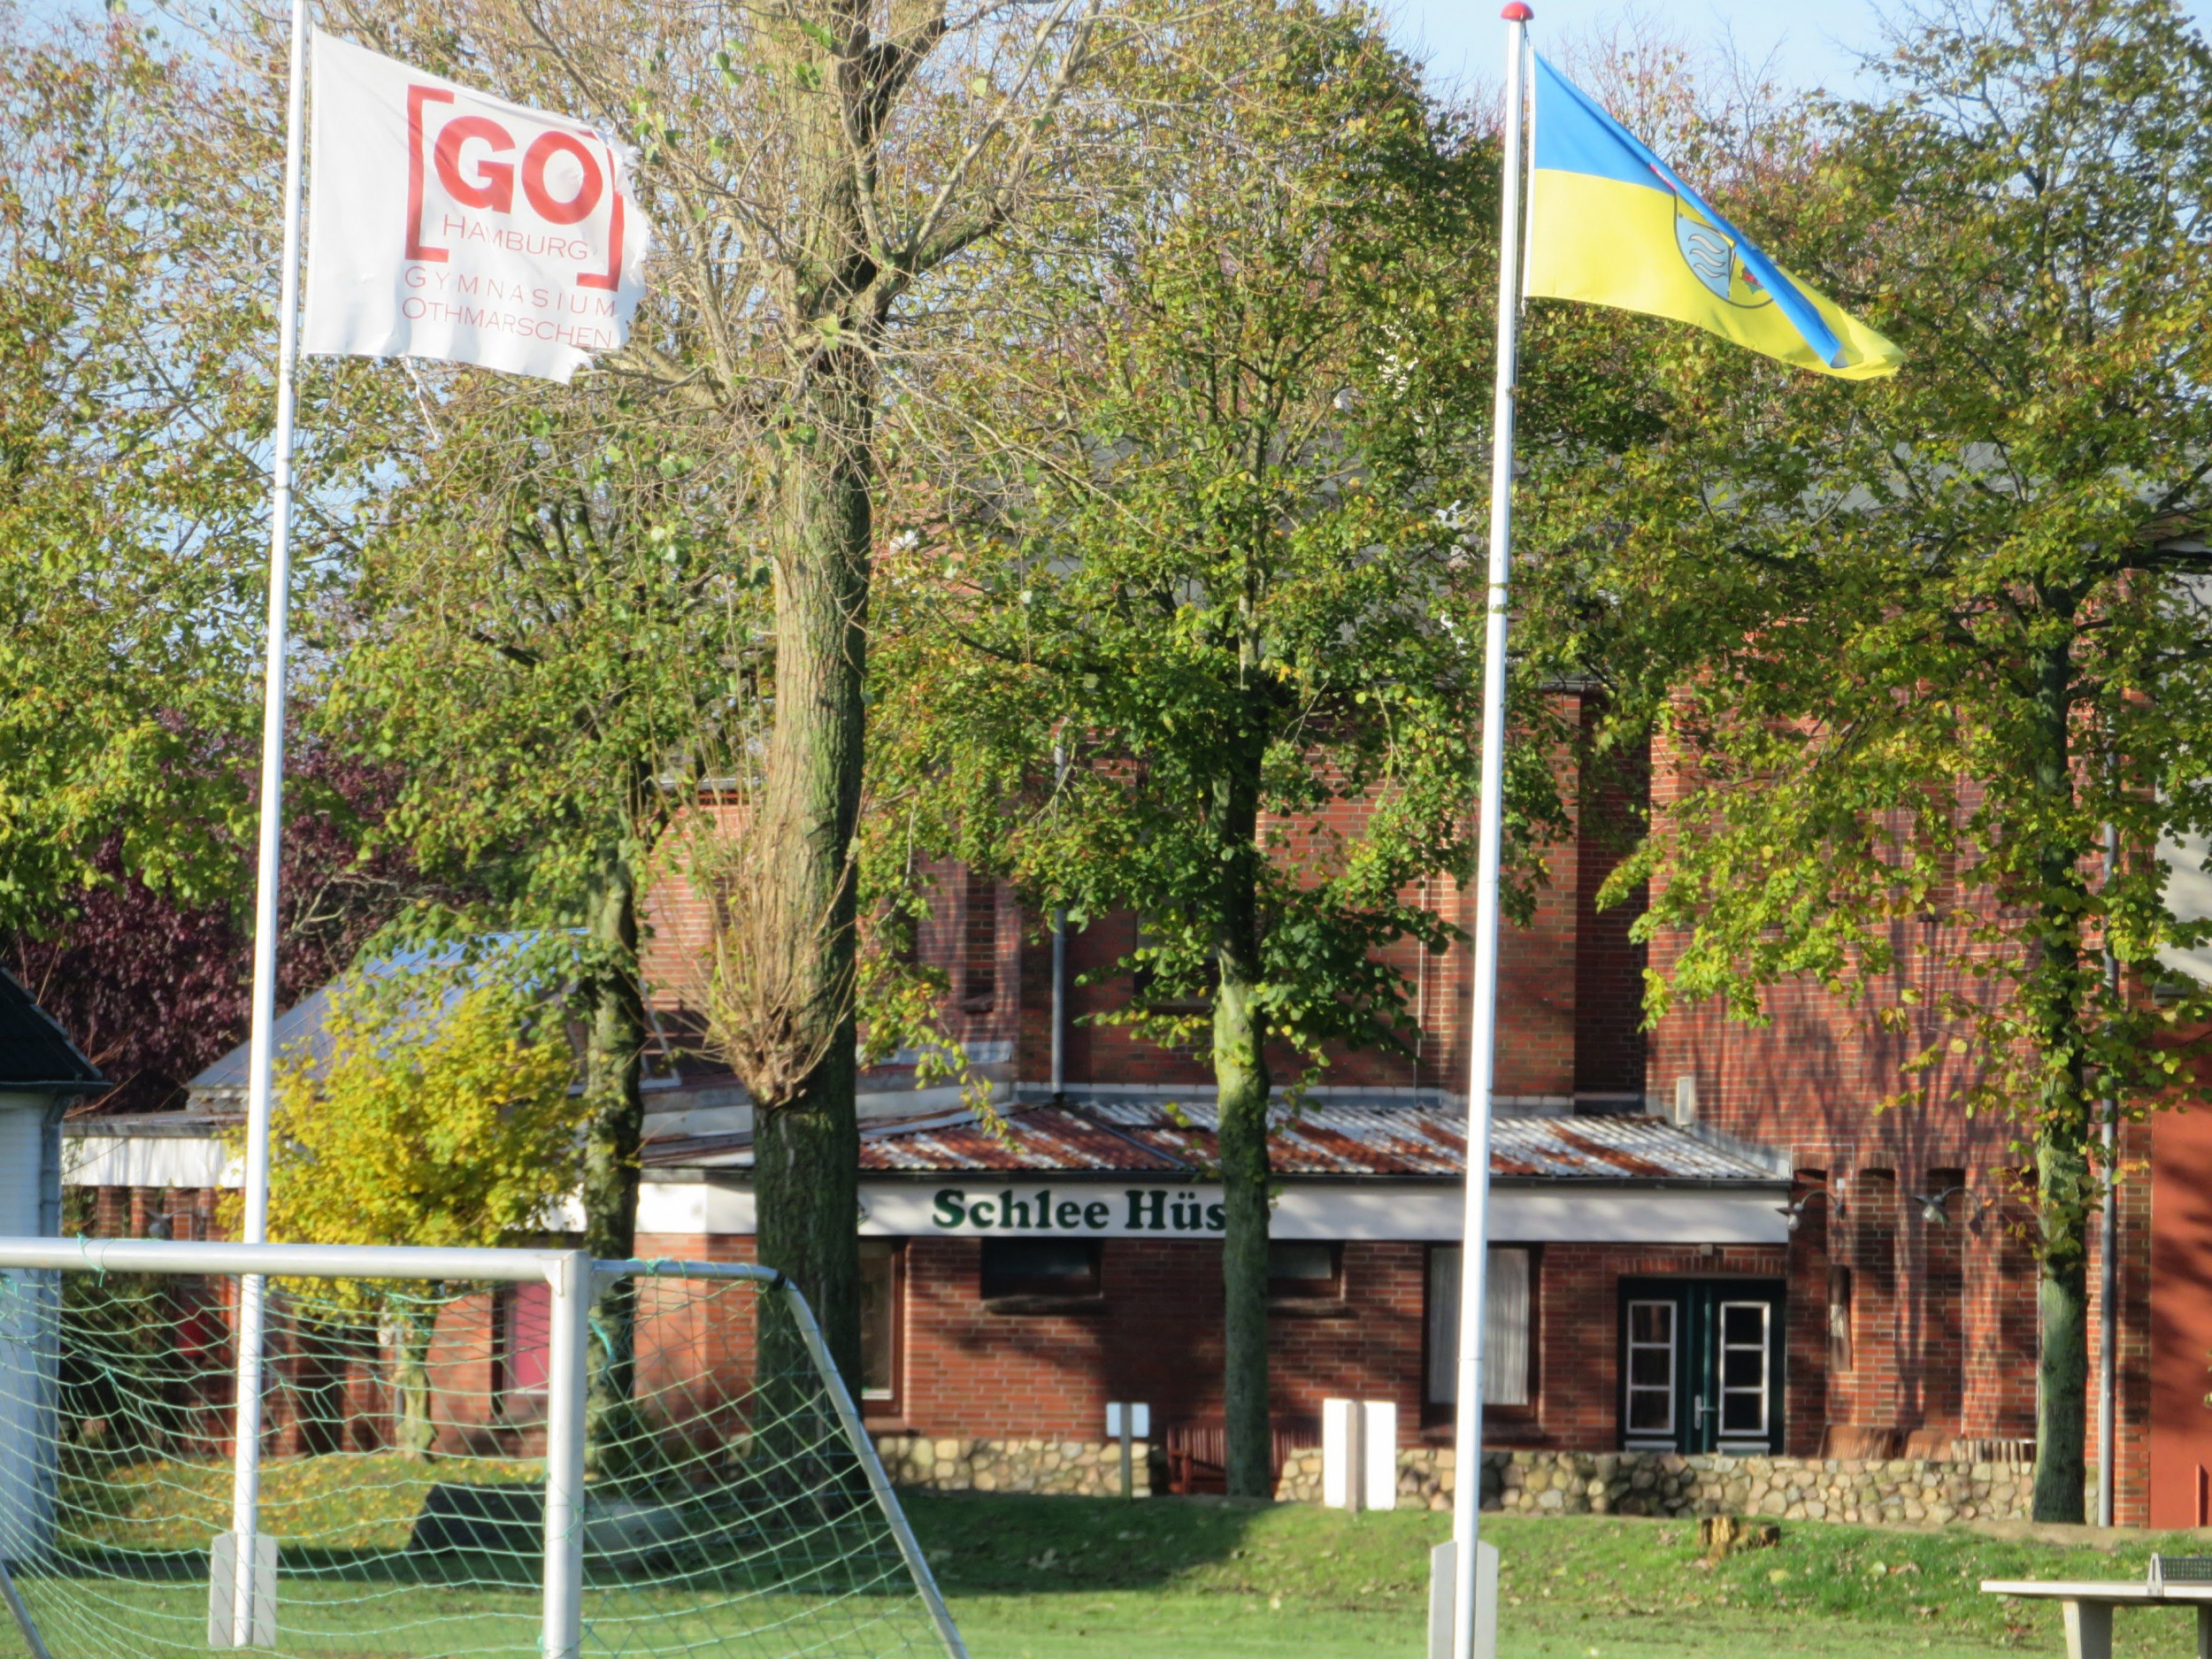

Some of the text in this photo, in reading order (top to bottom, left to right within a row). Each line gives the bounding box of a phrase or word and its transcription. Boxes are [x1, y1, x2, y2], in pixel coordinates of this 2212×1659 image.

[433, 115, 603, 226] GO
[442, 213, 588, 260] HAMBURG
[404, 265, 616, 318] GYMNASIUM
[402, 296, 612, 349] OTHMARSCHEN
[932, 1188, 1110, 1230] Schlee
